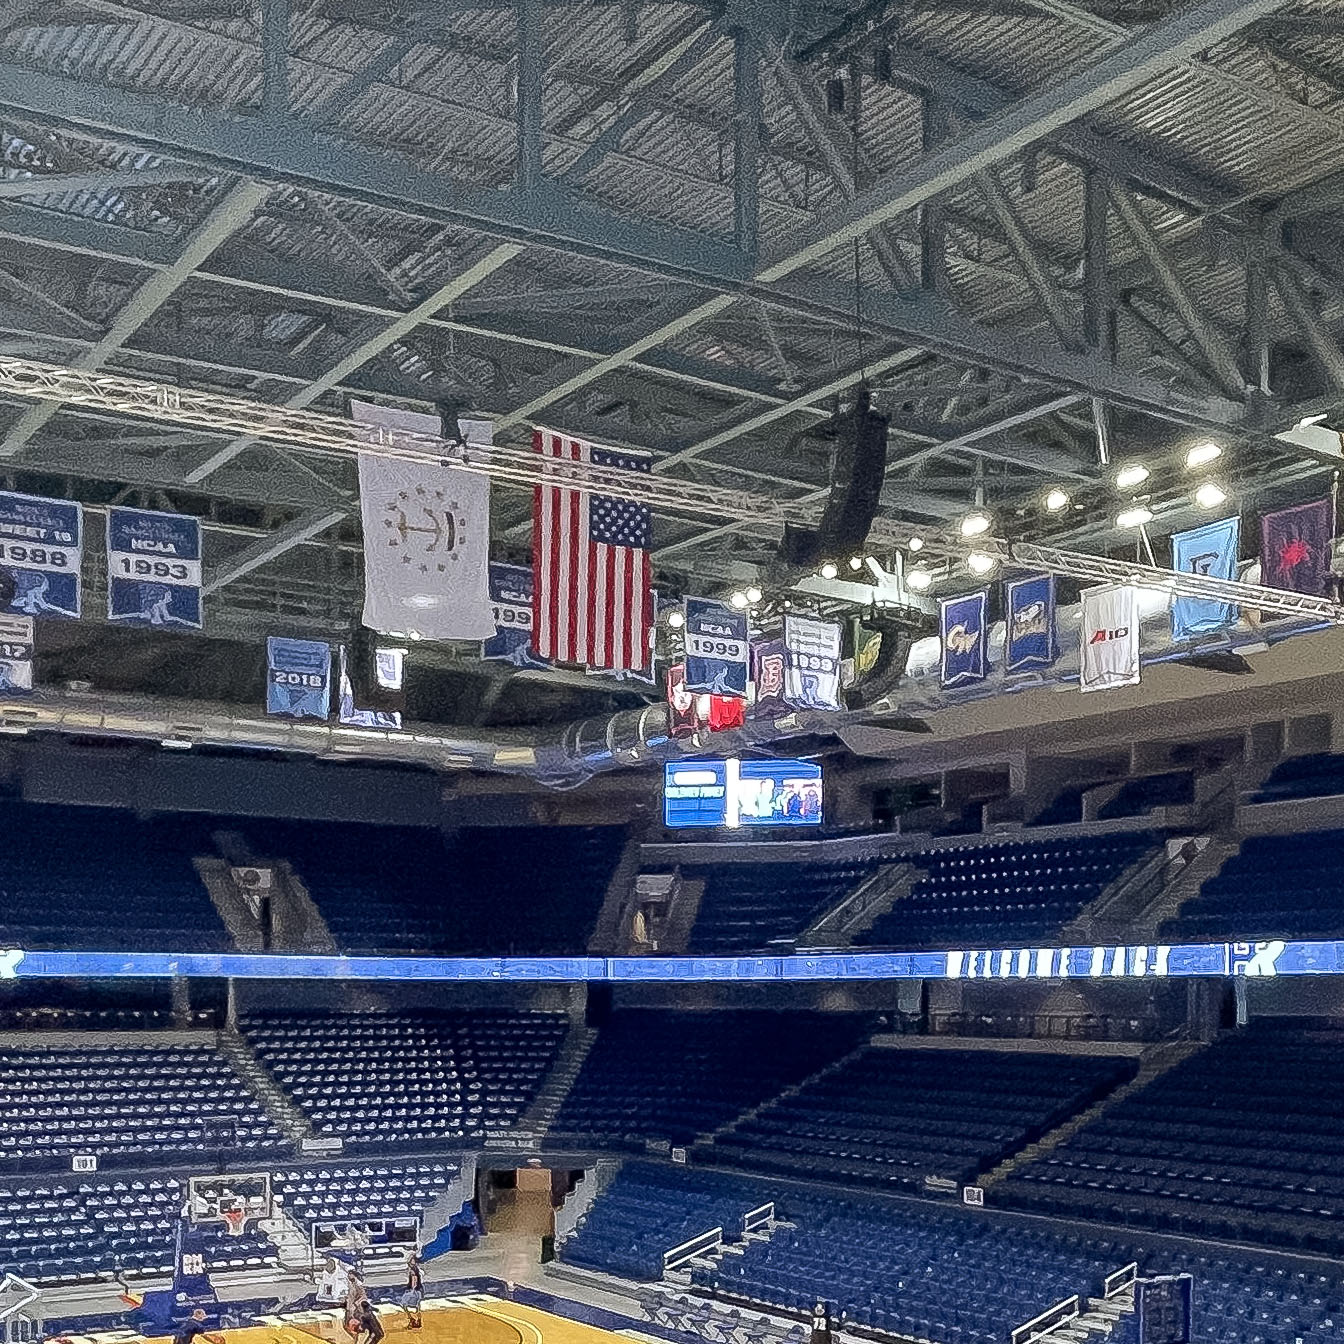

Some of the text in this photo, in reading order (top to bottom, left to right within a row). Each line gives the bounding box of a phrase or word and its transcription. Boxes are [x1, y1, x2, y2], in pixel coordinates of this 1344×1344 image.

[121, 557, 188, 580] 1993
[493, 606, 532, 624] 199
[692, 639, 740, 656] 1999
